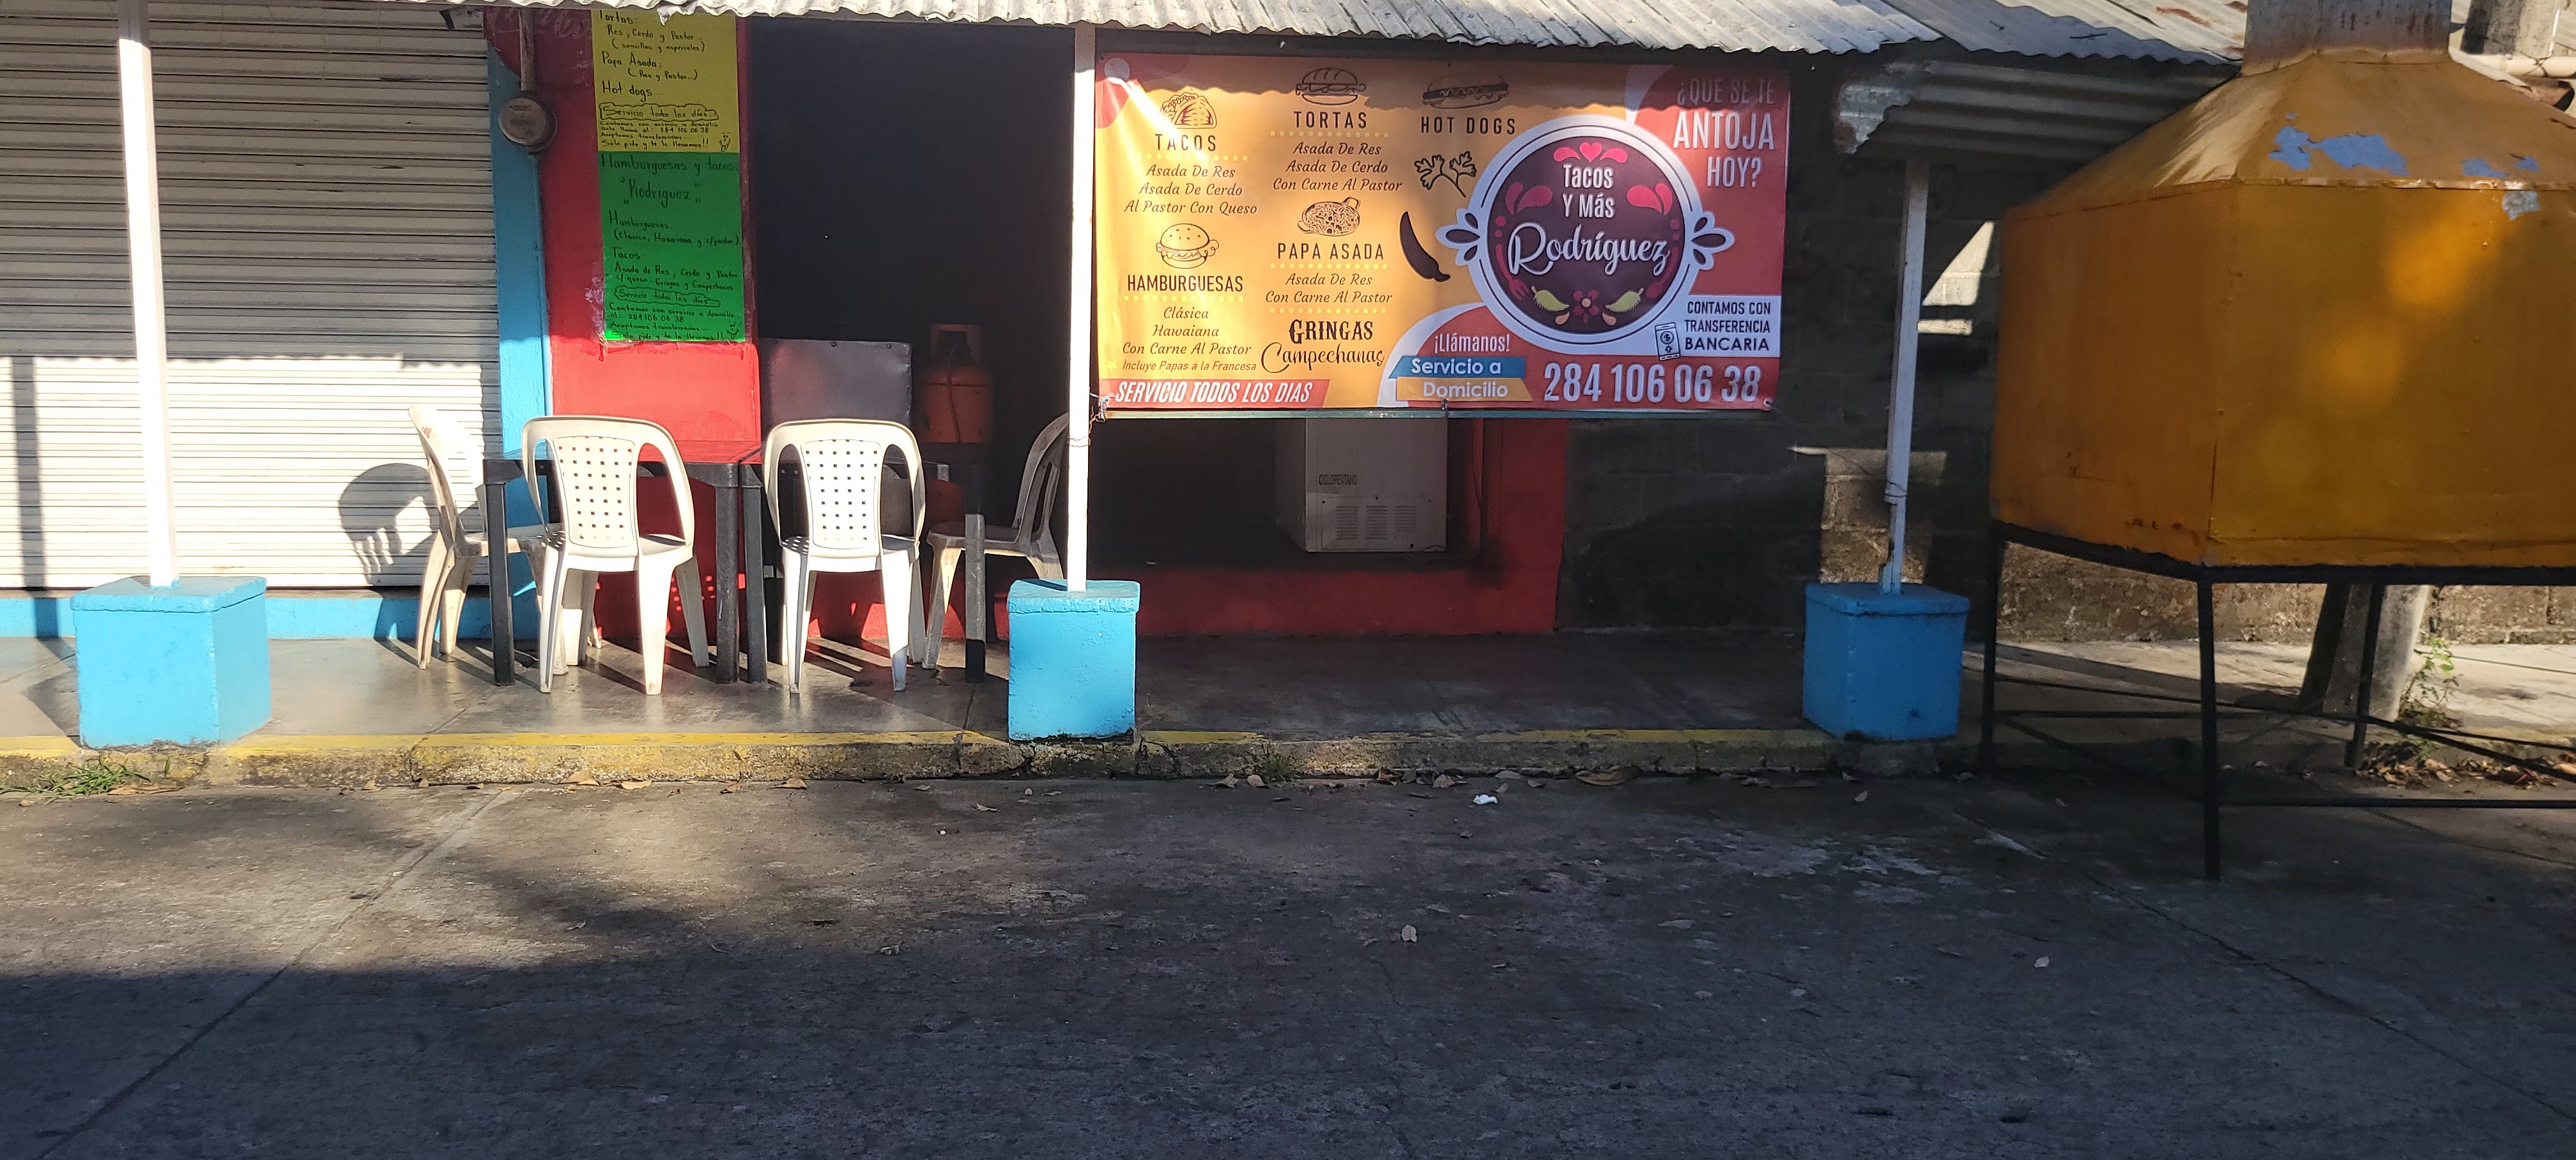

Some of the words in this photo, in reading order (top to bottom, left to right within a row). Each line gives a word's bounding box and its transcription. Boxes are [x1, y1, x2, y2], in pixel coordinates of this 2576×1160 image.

[632, 27, 654, 38] Cerdo
[660, 34, 665, 42] y
[602, 51, 622, 67] Papa
[602, 80, 623, 95] Hot
[1677, 78, 1722, 105] ¿QUE
[1731, 78, 1749, 103] SE
[1758, 79, 1774, 104] TE
[603, 106, 643, 117] Servicio
[674, 109, 687, 118] los
[1294, 111, 1367, 128] TORTAS
[1421, 116, 1455, 134] HOT
[1466, 117, 1515, 134] DOGS
[1673, 111, 1774, 150] ANTOJA
[624, 140, 638, 149] pide
[1154, 134, 1216, 151] TACOS
[1292, 141, 1334, 155] Asada
[1338, 142, 1354, 155] De
[1358, 143, 1382, 155] Res
[601, 154, 687, 175] Hamburguesas
[694, 163, 701, 176] y
[1146, 164, 1187, 177] Asada
[1192, 165, 1208, 177] De
[1213, 165, 1236, 178] Res
[1285, 160, 1326, 172] Asada
[1331, 160, 1347, 173] De
[1352, 160, 1388, 173] Cerdo
[1706, 156, 1762, 188] HOY?
[1563, 164, 1614, 189] Tacos
[1138, 182, 1180, 195] Asada
[1184, 183, 1201, 195] De
[1206, 183, 1243, 196] Cerdo
[1273, 178, 1296, 190] Con
[1301, 178, 1338, 191] Carne
[1342, 178, 1357, 191] Al
[1360, 179, 1402, 192] Pastor
[1124, 199, 1138, 213] Al
[1142, 201, 1186, 213] Pastor
[1190, 202, 1213, 213] Con
[1219, 202, 1257, 216] Queso
[1563, 194, 1574, 218] Y
[1579, 192, 1616, 218] Más
[698, 240, 702, 248] y
[1278, 243, 1321, 259] PAPA
[1330, 243, 1384, 260] ASADA
[1508, 222, 1671, 277] Rodríguez
[615, 262, 639, 273] Asada
[643, 265, 651, 274] de
[680, 268, 700, 277] Cerdo
[655, 279, 680, 287] Gringas
[684, 281, 689, 290] y
[1128, 275, 1243, 292] HAMBURGUESAS
[1285, 273, 1326, 286] Asada
[1330, 273, 1346, 286] De
[1349, 273, 1373, 286] Res
[618, 289, 648, 299] Servicio
[653, 289, 671, 301] todos
[675, 291, 687, 303] los
[1266, 291, 1289, 303] Con
[1294, 291, 1330, 303] Carne
[1333, 290, 1349, 303] Al
[1351, 291, 1393, 303] Pastor
[610, 302, 648, 312] Contamos
[1163, 306, 1209, 319] Clásica
[1687, 301, 1745, 315] CONTAMOS
[1749, 302, 1771, 316] CON
[675, 315, 684, 323] 38
[1685, 319, 1771, 333] TRANSFERENCIA
[675, 331, 682, 340] lo
[1153, 324, 1220, 337] Hawaiana
[1289, 319, 1374, 344] GRINGAS
[1122, 342, 1145, 355] Con
[1150, 342, 1187, 355] Carne
[1190, 342, 1206, 355] Al
[1209, 343, 1252, 355] Pastor
[1434, 332, 1510, 354] ¡Llámanos!
[1685, 338, 1770, 352] BANCARIA
[1261, 342, 1385, 374] Campechanas
[1122, 360, 1156, 373] Incluye
[1159, 360, 1189, 372] Papas
[1200, 361, 1209, 370] la
[1212, 361, 1257, 371] Francesa
[1411, 358, 1483, 375] Servicio
[1489, 362, 1501, 375] a
[1423, 381, 1508, 398] Domicilio
[1544, 363, 1602, 402] 284
[1611, 363, 1665, 403] 106
[1674, 364, 1713, 403] 06
[1721, 365, 1761, 402] 38
[1115, 381, 1188, 403] SERVICIO
[1190, 381, 1240, 404] TODOS
[1241, 382, 1273, 404] LOS
[1275, 382, 1314, 403] DIAS
